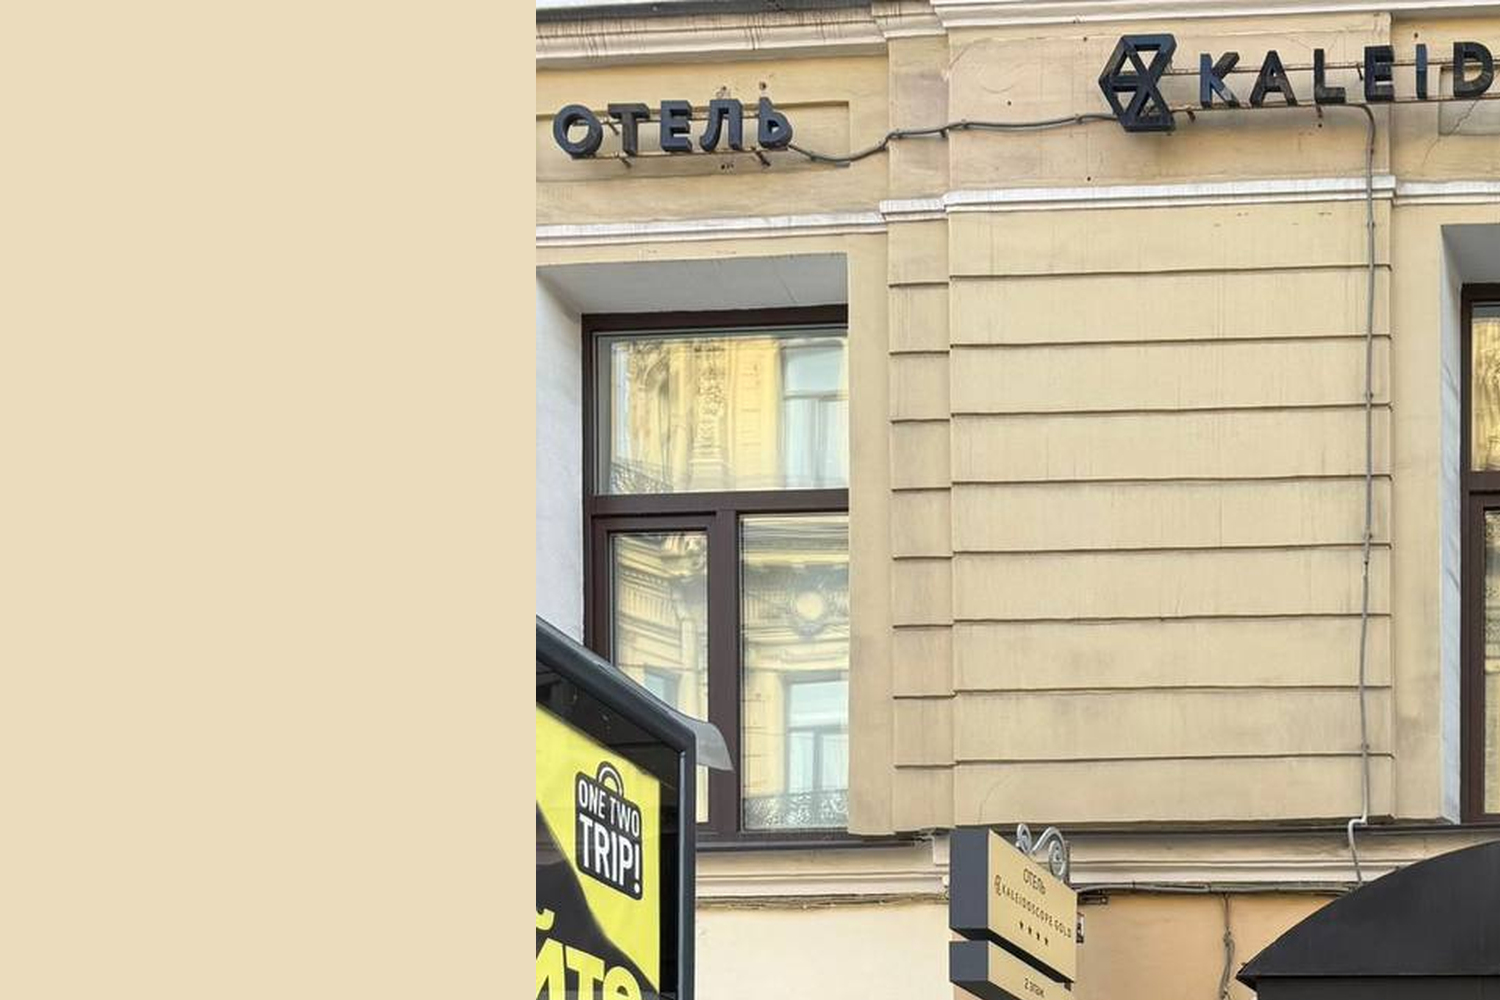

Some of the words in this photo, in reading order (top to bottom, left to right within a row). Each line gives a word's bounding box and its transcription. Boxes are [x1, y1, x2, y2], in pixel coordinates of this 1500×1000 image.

[553, 96, 793, 159] ОТЕЛЬ
[578, 779, 607, 819] ONE
[609, 796, 640, 837] TWO
[578, 812, 641, 894] TRIP!
[1023, 867, 1046, 895] ОТЕЛЬ
